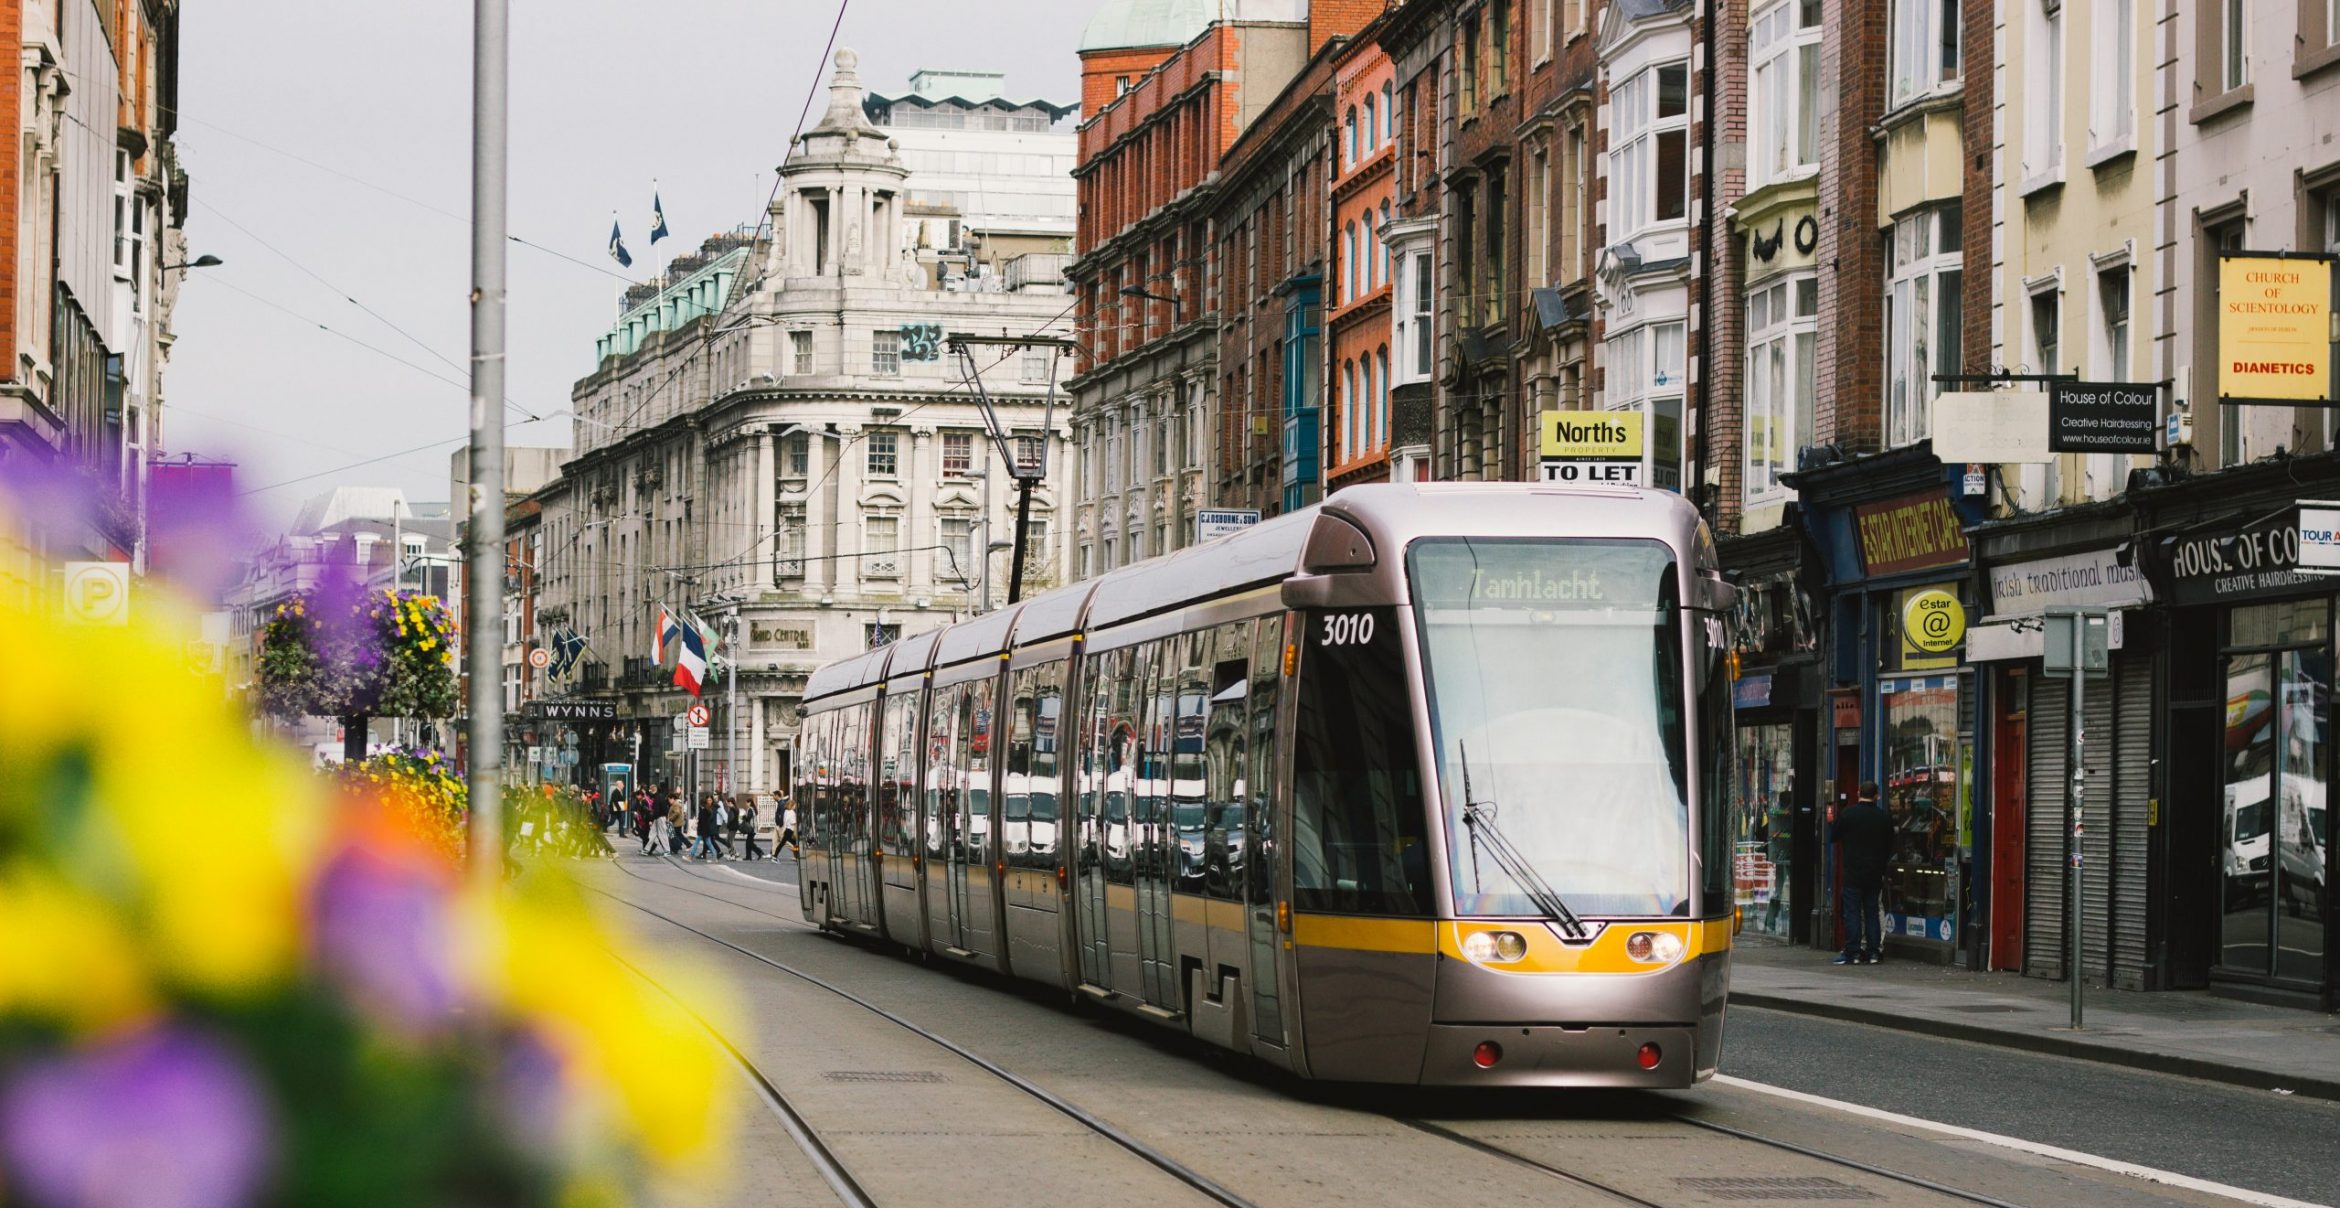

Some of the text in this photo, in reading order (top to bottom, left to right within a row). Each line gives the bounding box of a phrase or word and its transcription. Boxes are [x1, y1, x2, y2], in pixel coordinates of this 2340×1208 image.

[2246, 272, 2299, 284] CHURCH
[2265, 288, 2281, 298] OF
[2229, 303, 2319, 315] SCIENTOLOGY
[2233, 362, 2315, 375] DIANETICS
[2060, 390, 2152, 405] House of Colour
[2061, 417, 2152, 431] Creative Hairdressing
[1556, 421, 1627, 443] Norths
[2062, 434, 2151, 445] www.houseofcolour.ie
[1544, 465, 1637, 481] TO LET
[1889, 501, 1937, 559] INTERNET
[2301, 529, 2332, 541] TOUR
[2238, 532, 2263, 569] OF
[2027, 559, 2102, 595] traditional
[2215, 574, 2256, 594] CREATIVE
[1321, 613, 1374, 646] 3010
[1923, 639, 1953, 647] Internet
[545, 705, 614, 718] WYNNS
